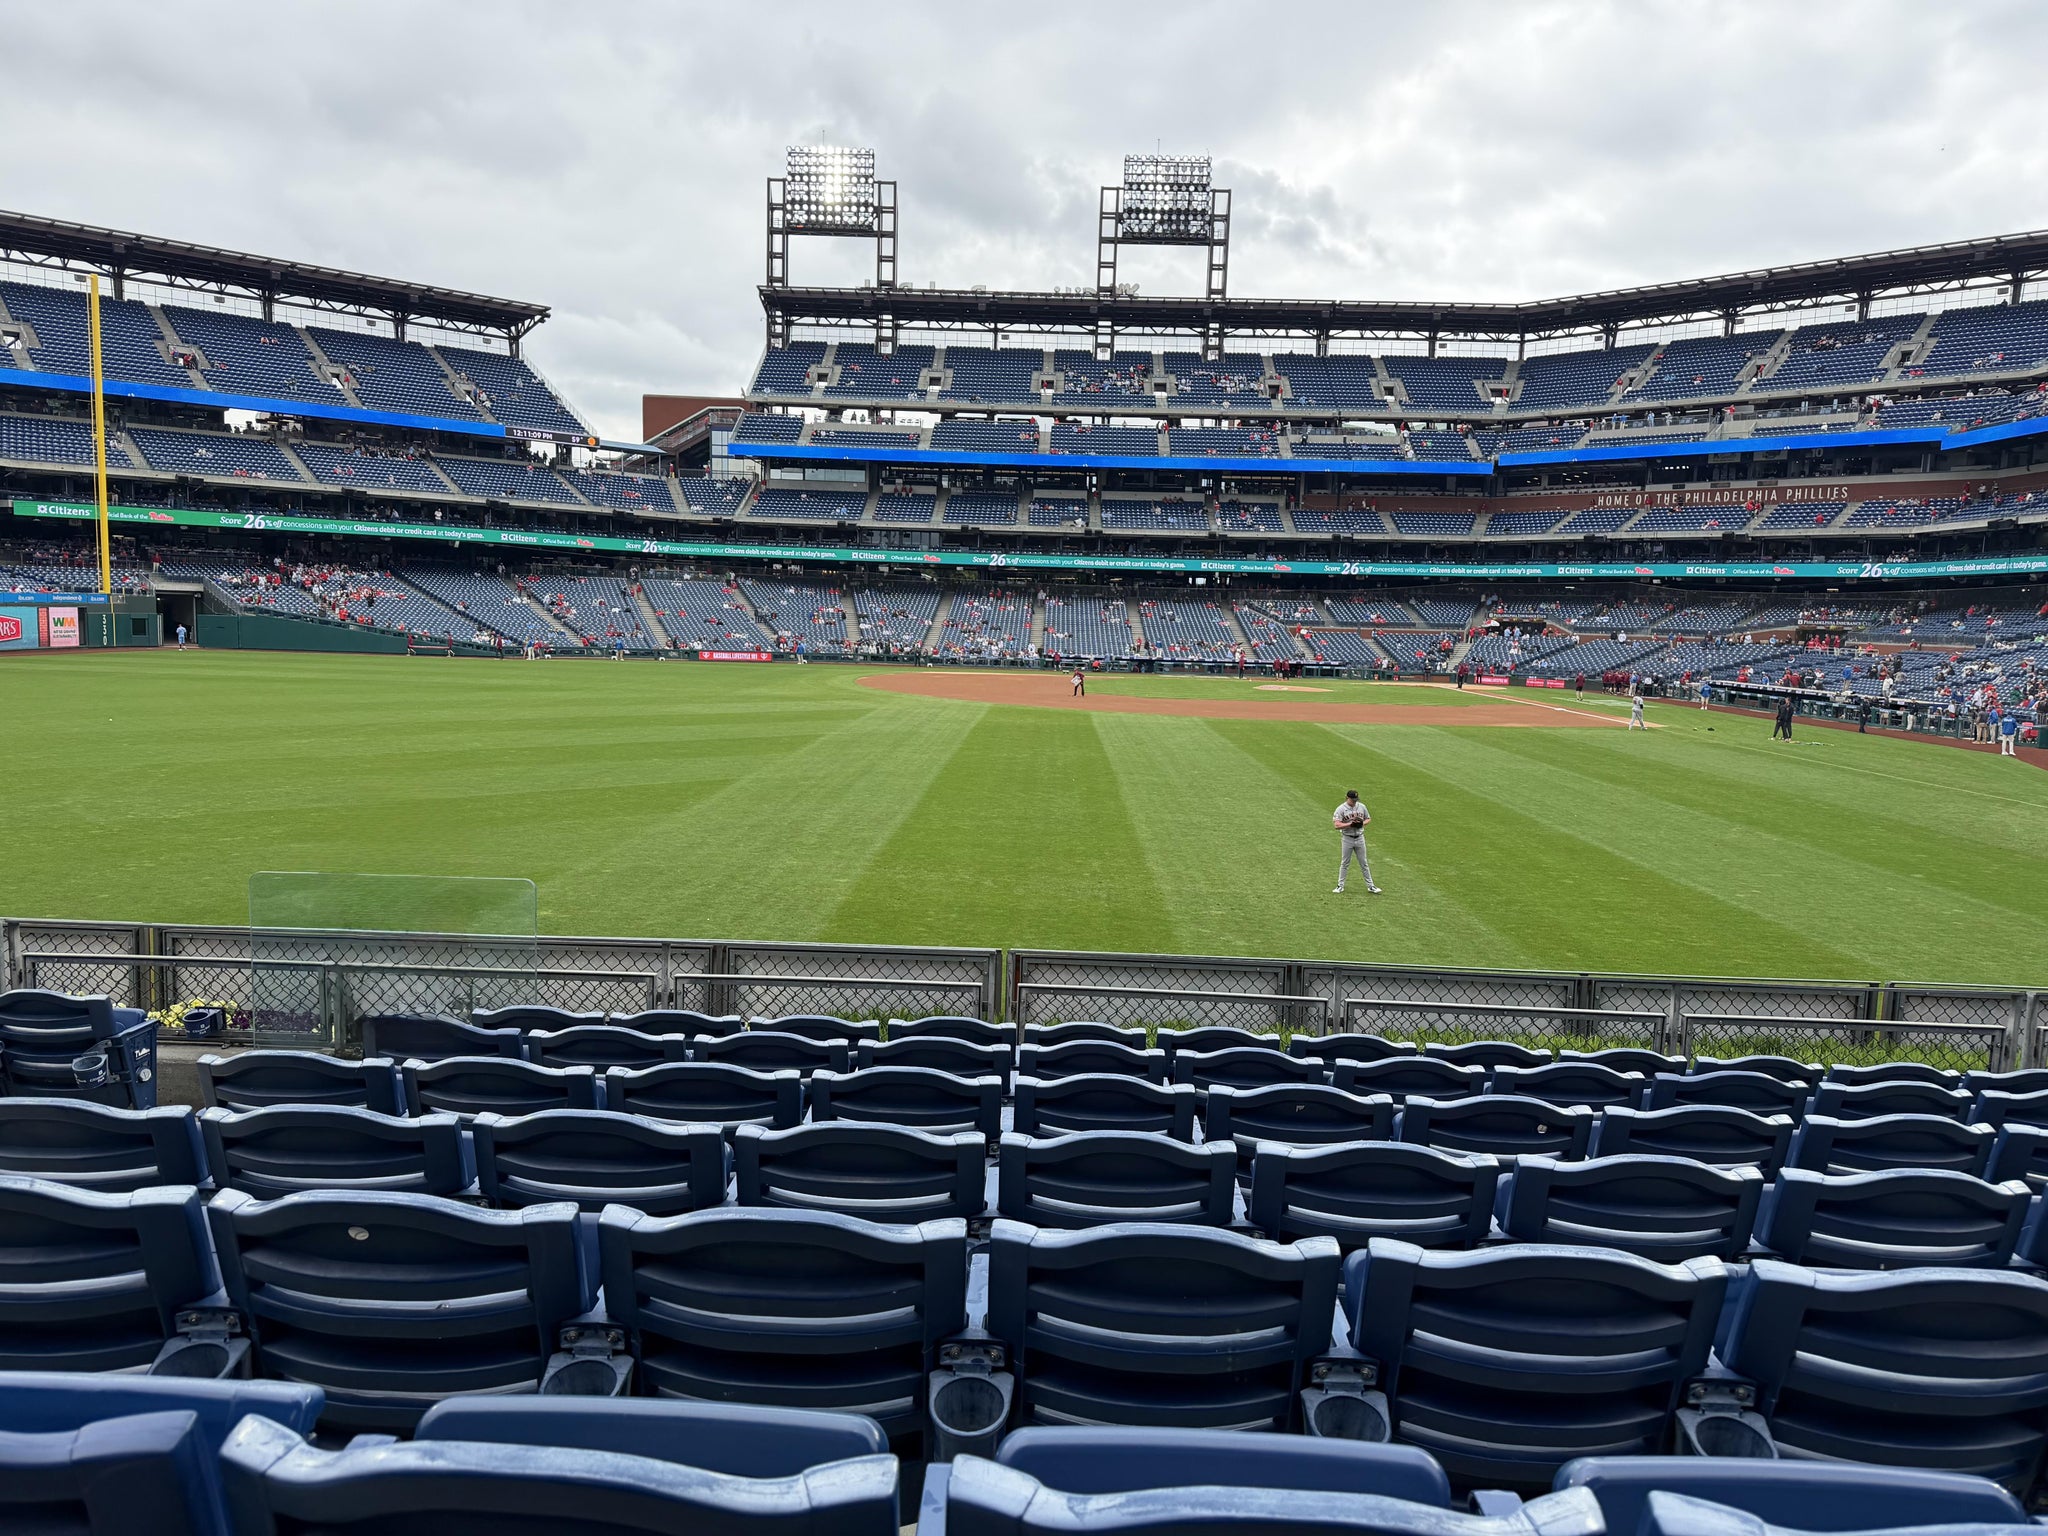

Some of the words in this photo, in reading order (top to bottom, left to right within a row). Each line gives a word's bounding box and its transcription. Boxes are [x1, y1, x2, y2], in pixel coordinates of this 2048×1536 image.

[513, 430, 541, 438] 12:11:09
[1598, 495, 1629, 506] HOME
[1656, 493, 1678, 505] THE
[1685, 490, 1778, 503] PHILADELPHIA
[1786, 487, 1848, 500] PHILLIES
[48, 506, 90, 516] Citizens
[220, 516, 242, 525] Score
[283, 521, 322, 530] concessions
[508, 534, 537, 542] Citizens
[1694, 566, 1726, 574] Citizens
[1837, 567, 1858, 575] Score
[53, 617, 75, 627] WM
